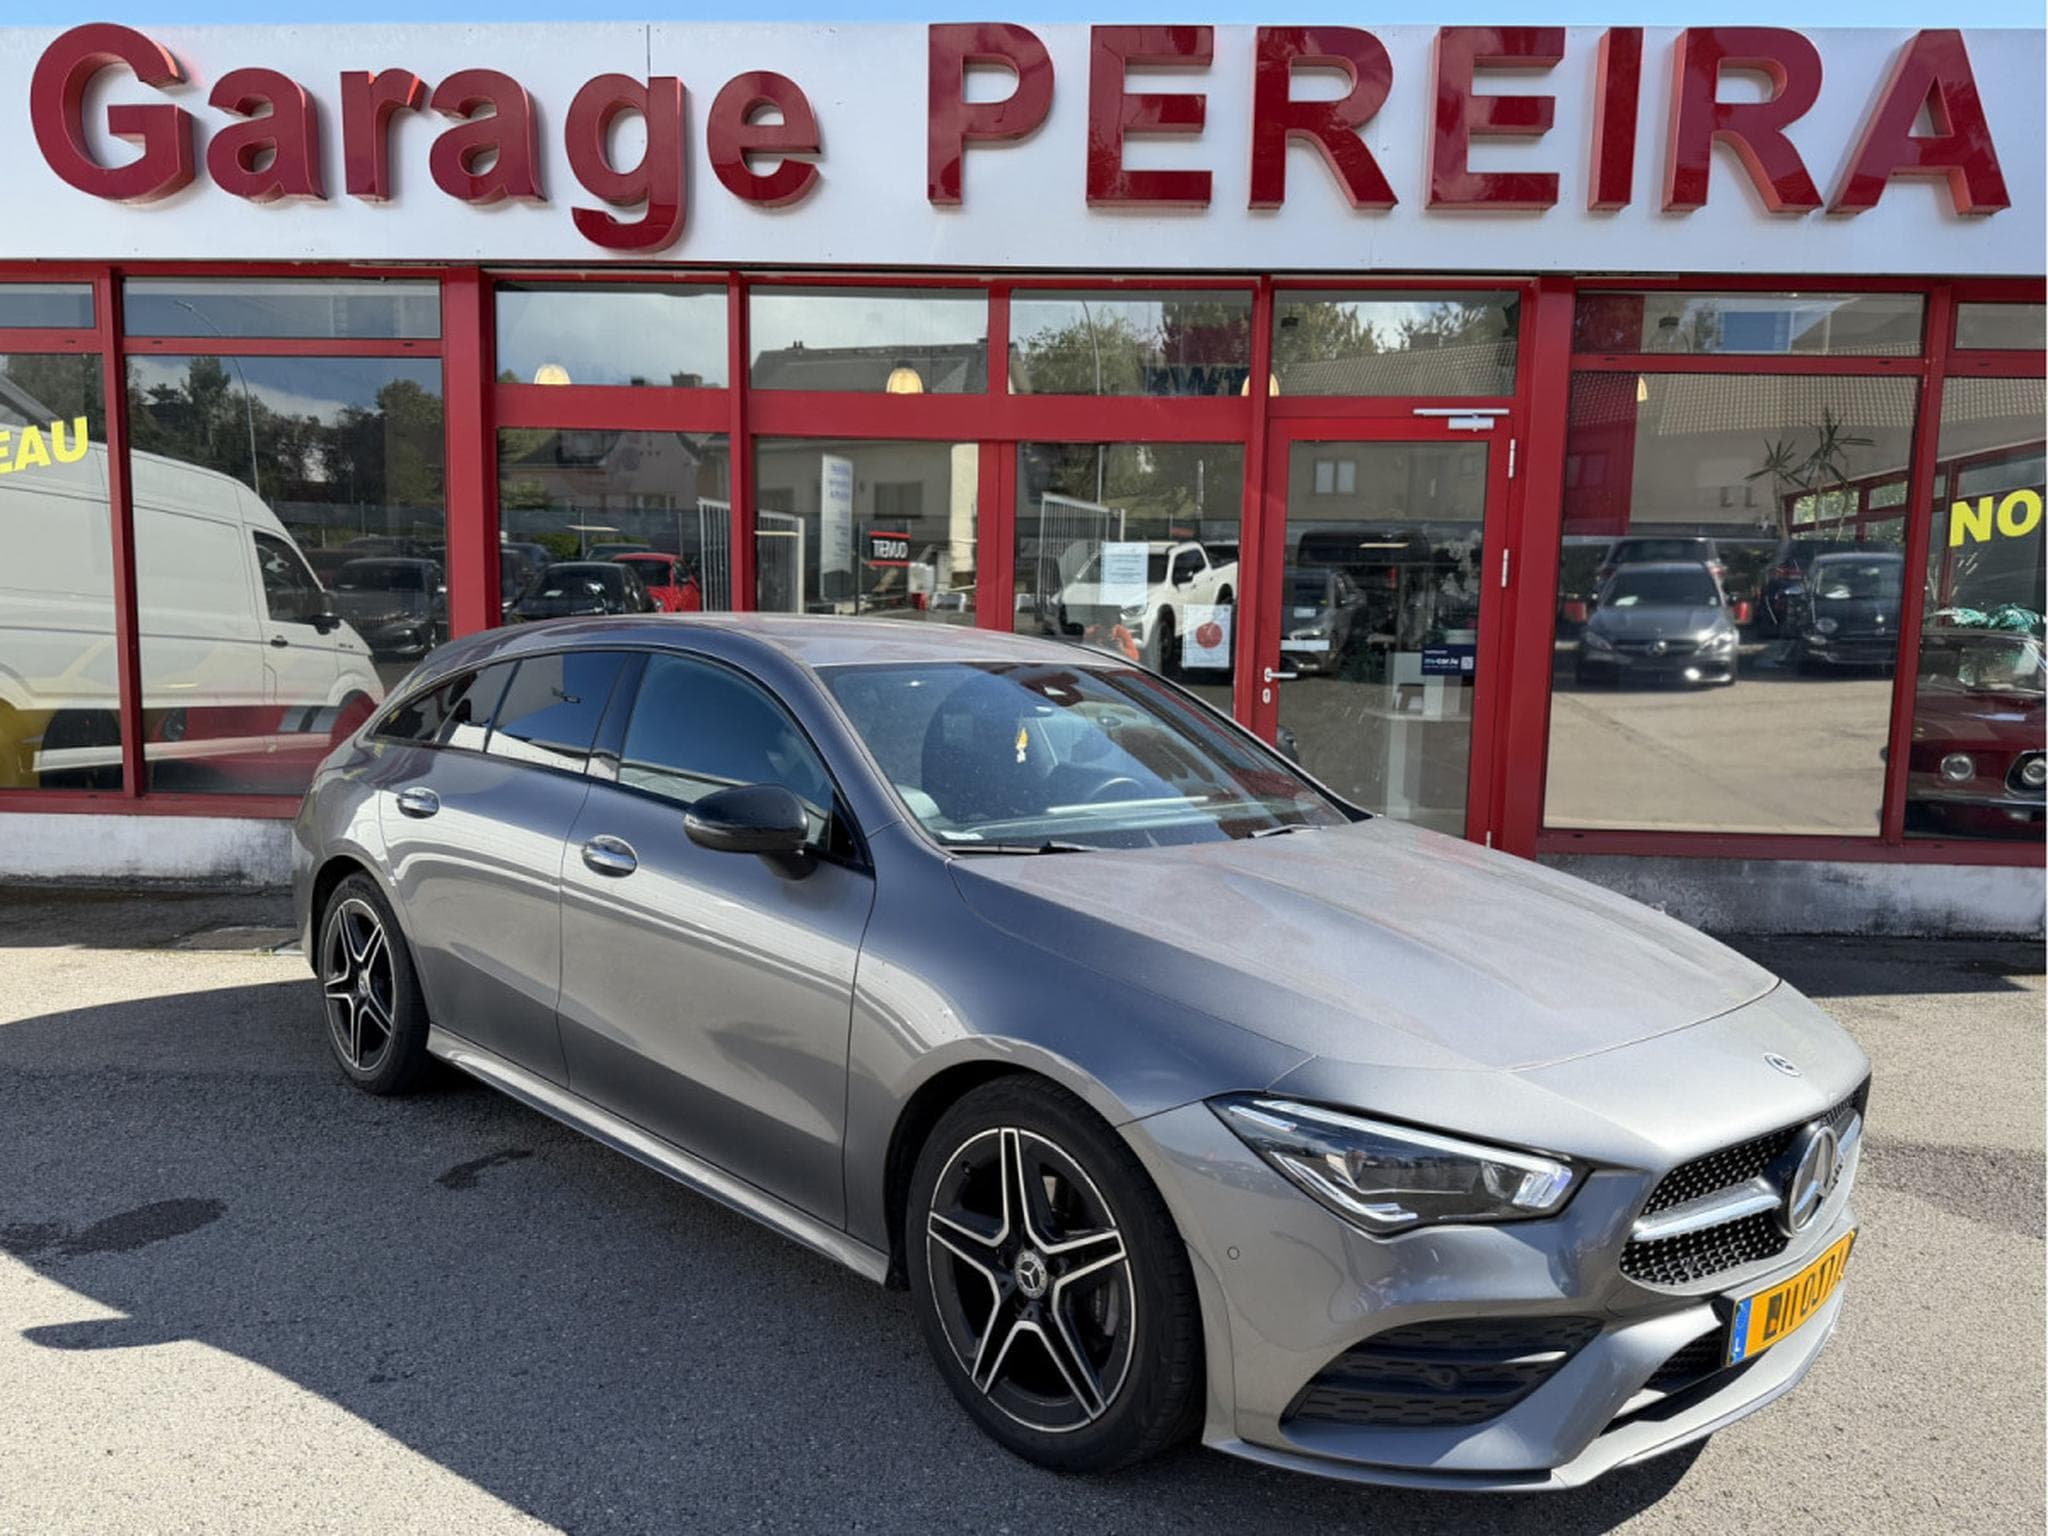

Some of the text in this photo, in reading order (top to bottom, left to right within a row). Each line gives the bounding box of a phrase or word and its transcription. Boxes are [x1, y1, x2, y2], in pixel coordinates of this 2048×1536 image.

[30, 22, 2011, 252] Garage PEREIRA
[1948, 489, 2043, 547] NO
